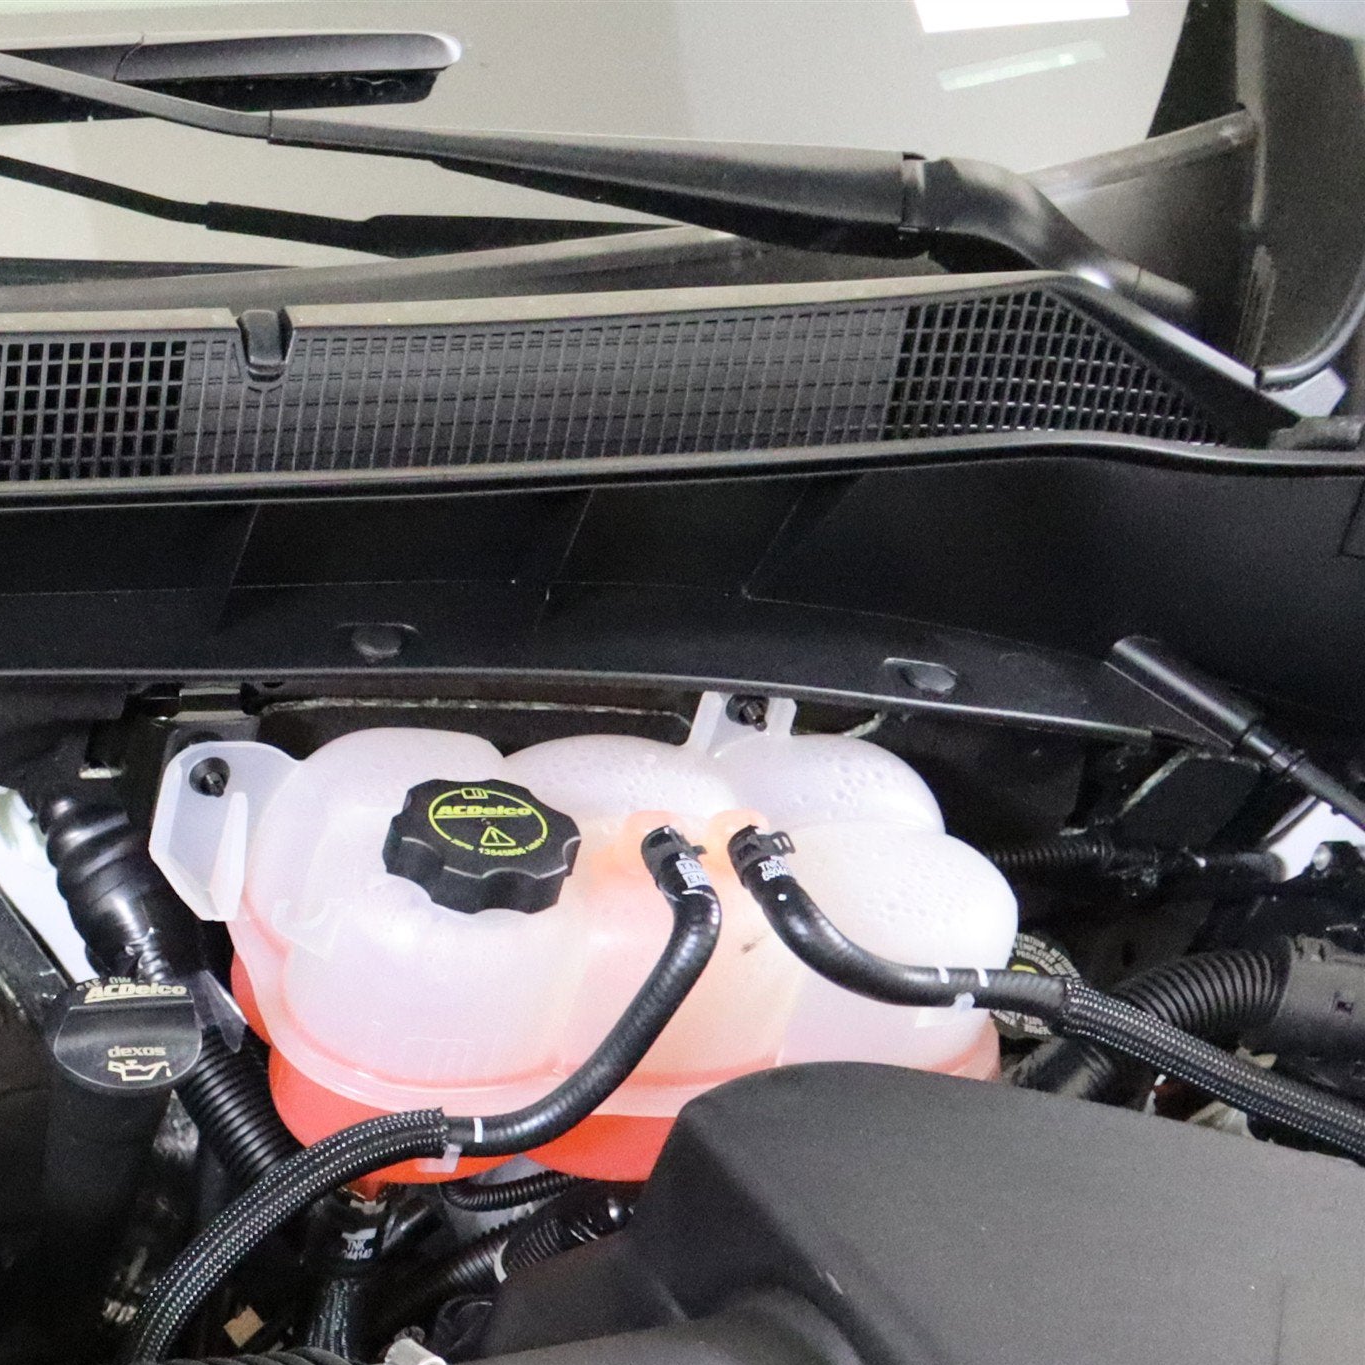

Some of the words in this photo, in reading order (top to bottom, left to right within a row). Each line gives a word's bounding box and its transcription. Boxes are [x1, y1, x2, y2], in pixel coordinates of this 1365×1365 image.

[435, 805, 532, 818] ACDelco
[84, 983, 188, 1003] ACDelco
[107, 1045, 167, 1058] dexos
